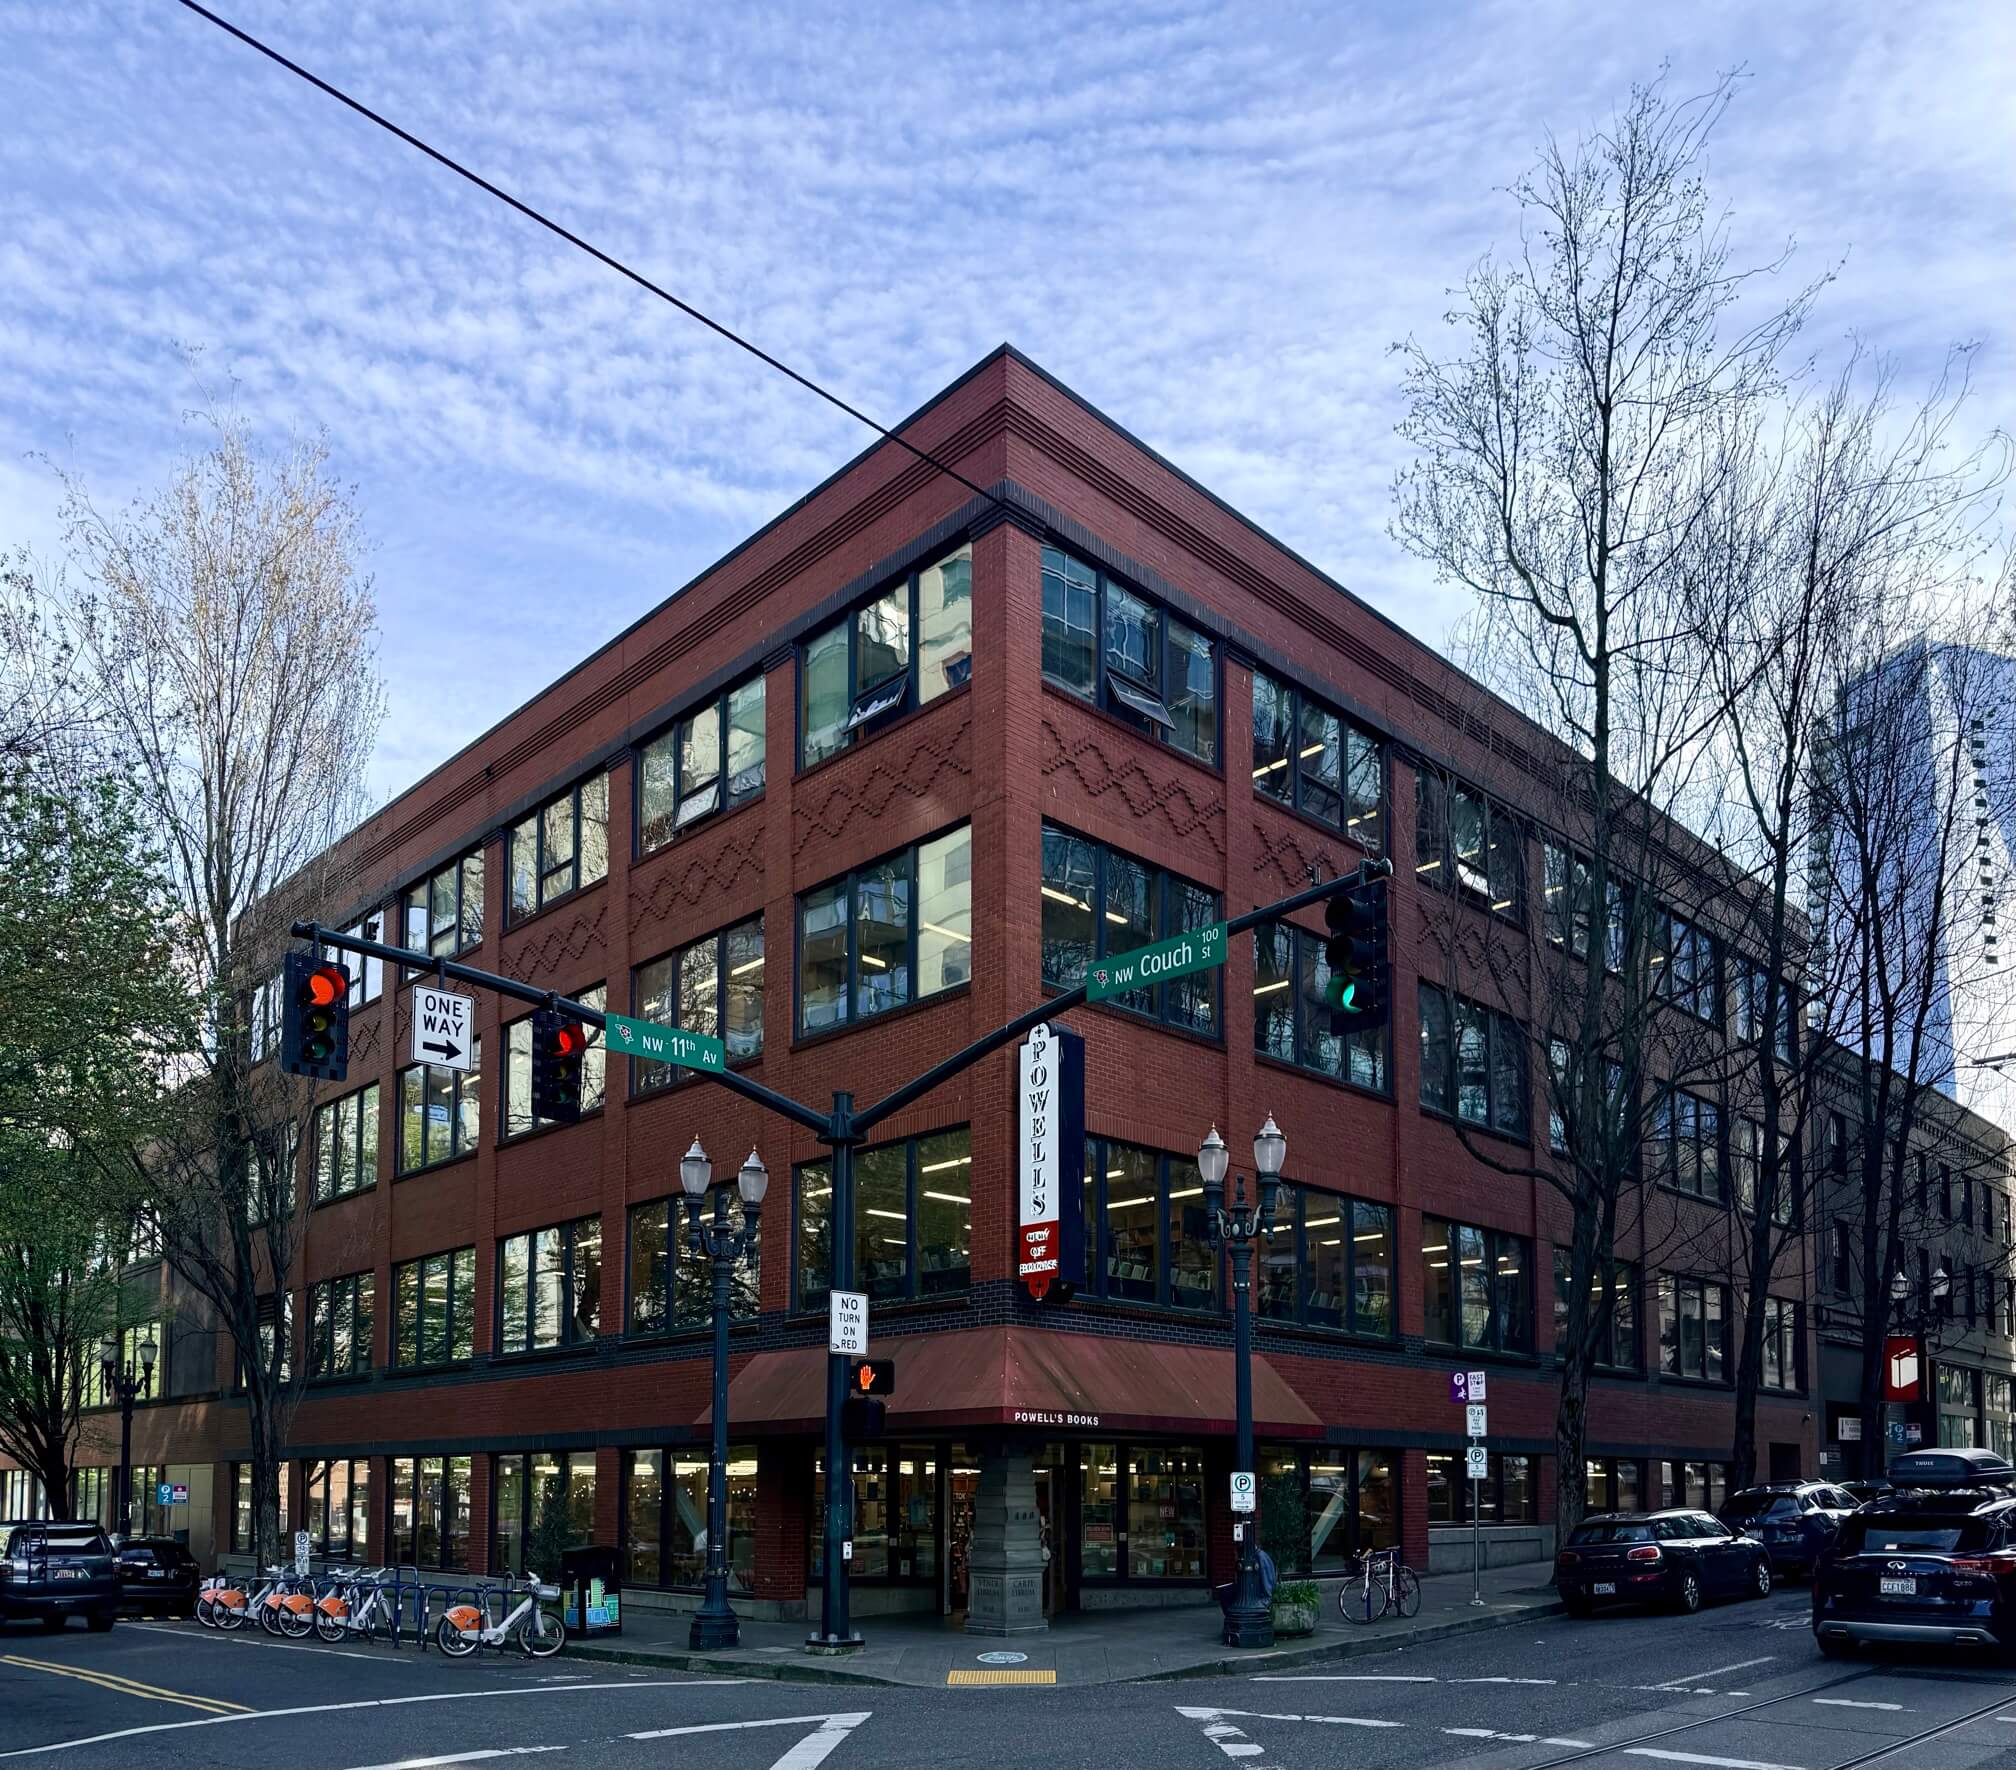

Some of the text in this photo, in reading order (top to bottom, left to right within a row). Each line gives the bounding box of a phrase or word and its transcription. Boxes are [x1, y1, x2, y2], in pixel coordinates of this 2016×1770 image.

[1202, 928, 1219, 943] 100
[1202, 947, 1211, 959] St
[1115, 942, 1192, 984] NW Couch
[425, 995, 464, 1018] ONE
[424, 1014, 464, 1037] WAY
[643, 1035, 717, 1065] NW 11th Av
[841, 1297, 858, 1310] NO
[838, 1312, 860, 1324] TURN
[843, 1326, 856, 1336] ON
[841, 1339, 858, 1350] RED
[1014, 1412, 1099, 1426] POWELL'S BOOKS
[1159, 1505, 1175, 1518] NEW
